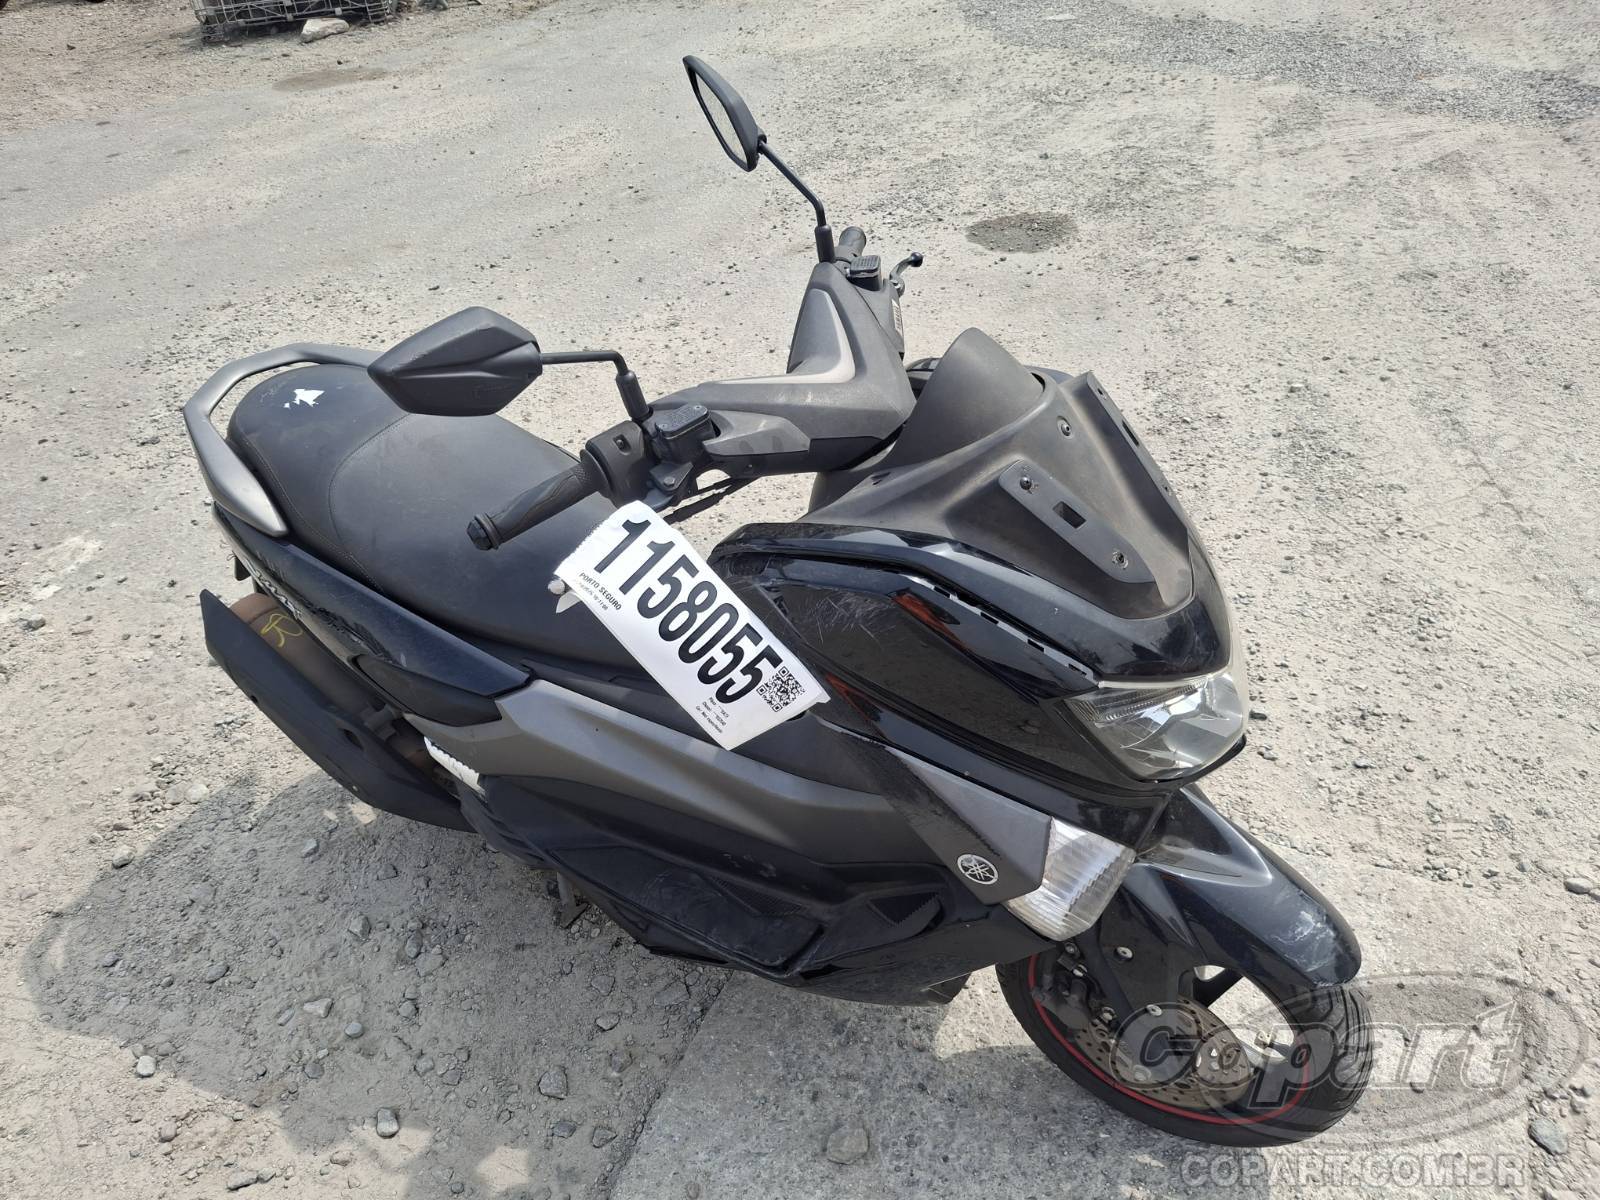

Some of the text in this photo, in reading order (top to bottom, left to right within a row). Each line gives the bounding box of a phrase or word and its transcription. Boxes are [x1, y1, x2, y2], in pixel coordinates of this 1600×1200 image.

[579, 572, 600, 589] PORTO
[599, 586, 622, 610] SEGURO
[593, 519, 783, 705] 1158055
